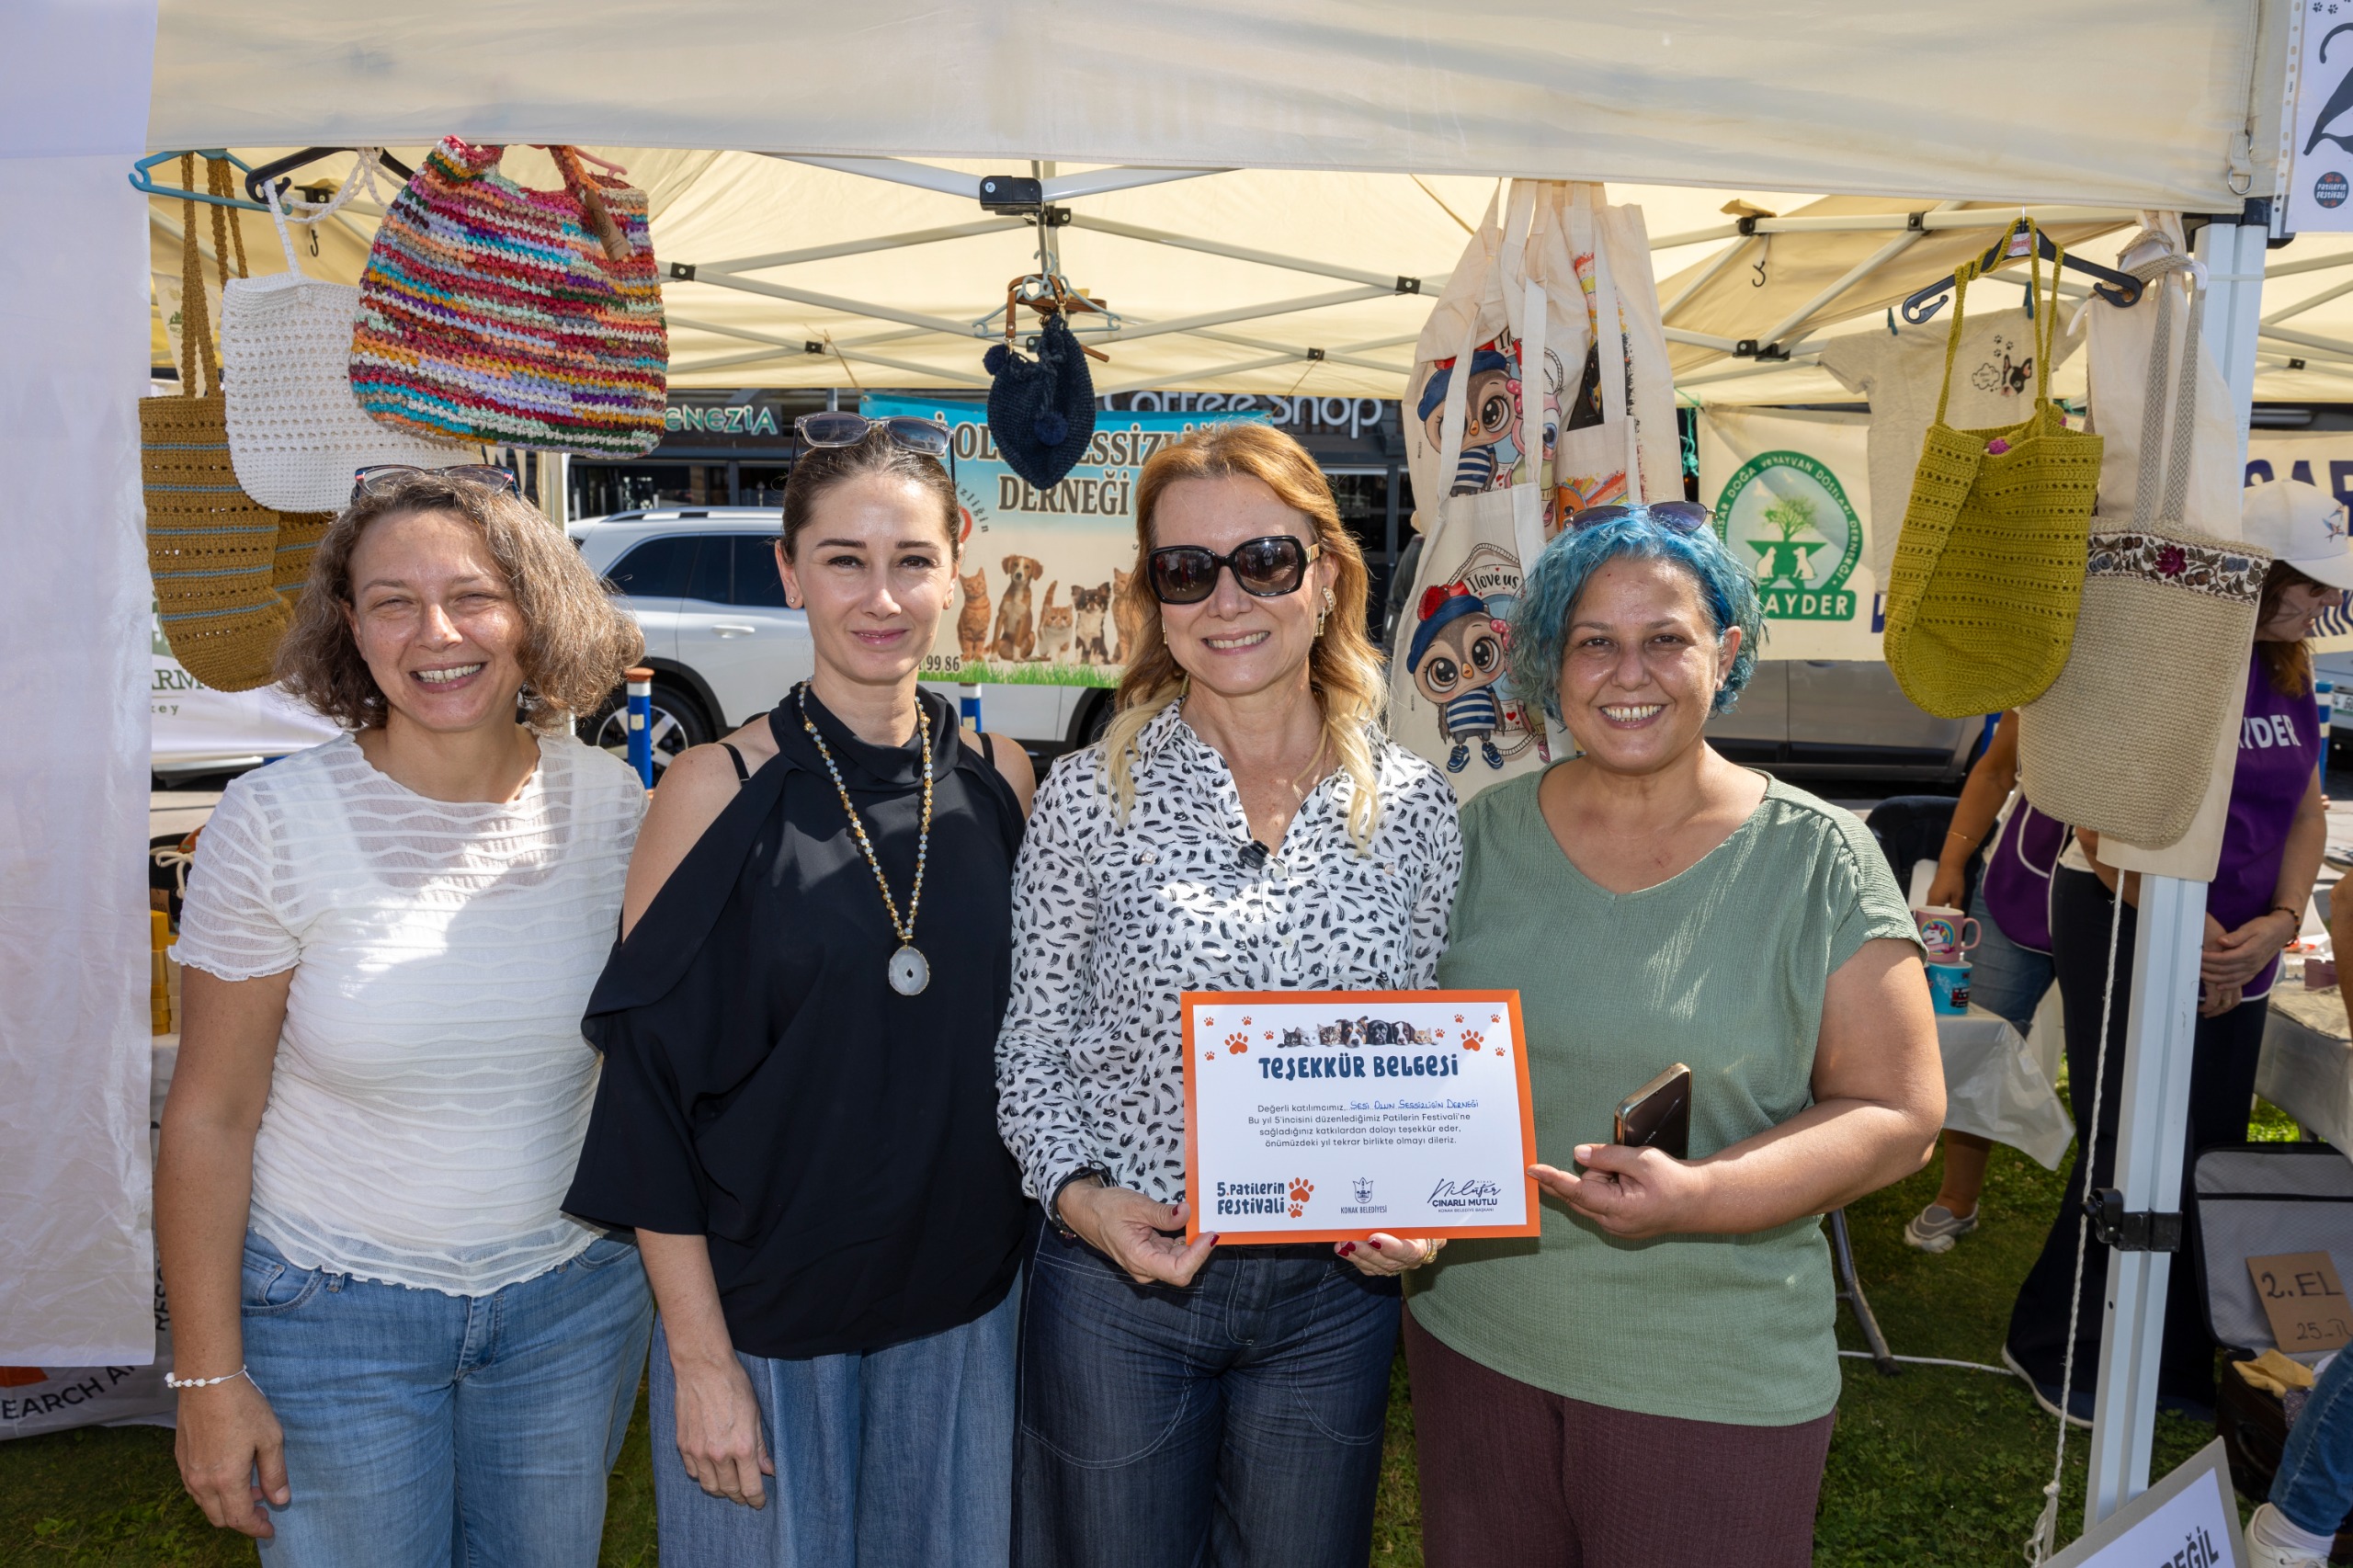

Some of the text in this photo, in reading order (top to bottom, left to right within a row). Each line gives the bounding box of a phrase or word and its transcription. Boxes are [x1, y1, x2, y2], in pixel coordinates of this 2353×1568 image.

[1503, 574, 1519, 590] us
[1257, 1104, 1290, 1114] Değerli
[1248, 1116, 1259, 1124] Bu
[1262, 1116, 1271, 1126] yıl
[1315, 1113, 1381, 1124] düzenlediğimiz
[1382, 1113, 1419, 1121] Patilerin
[1422, 1112, 1471, 1121] Festivali'ne
[1259, 1124, 1461, 1137] sağladığınız katkılardan dolayı teşekkür eder,
[1265, 1138, 1318, 1147] önümüzdeki
[1321, 1138, 1330, 1148] yıl
[1363, 1137, 1394, 1145] birlikte
[1396, 1137, 1426, 1146] olmayı
[1427, 1135, 1457, 1144] dileriz.
[1359, 1204, 1388, 1214] BELEDİYESİ
[1432, 1198, 1498, 1208] ÇINARLI MUTLU
